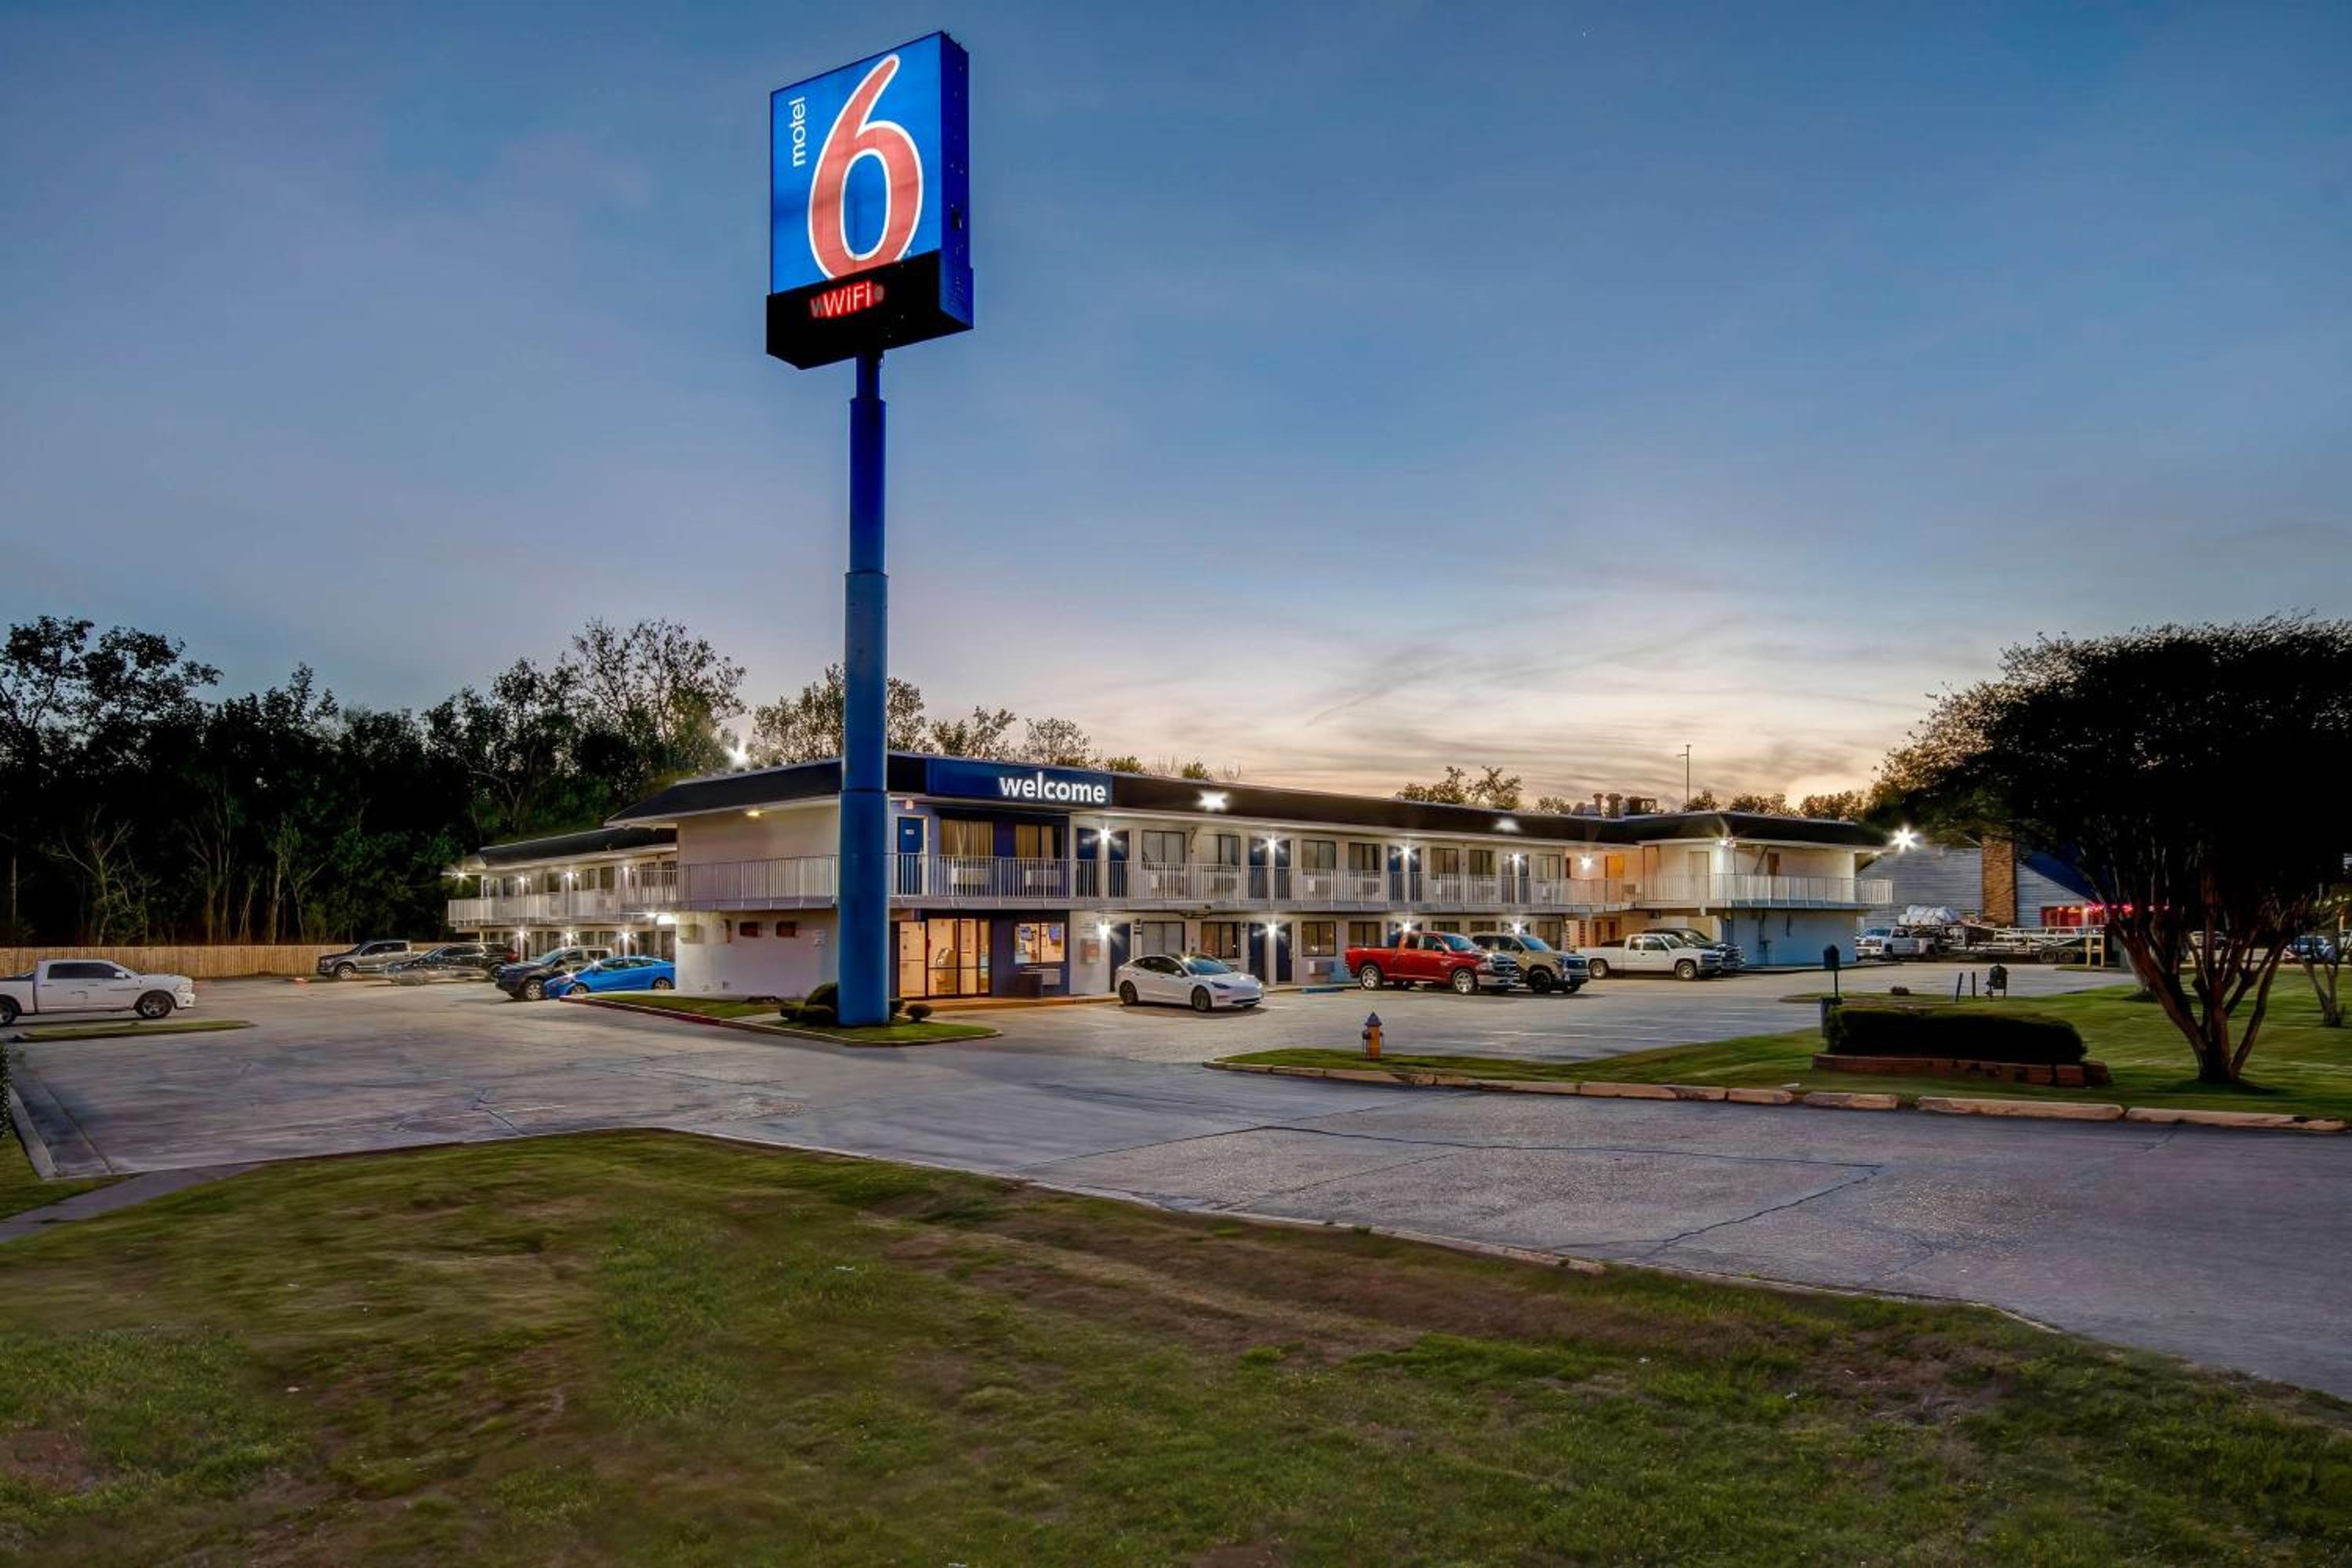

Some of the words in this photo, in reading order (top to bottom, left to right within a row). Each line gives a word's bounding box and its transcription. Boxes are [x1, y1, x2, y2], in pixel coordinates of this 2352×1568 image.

[788, 96, 806, 167] motel
[808, 54, 924, 280] 6
[999, 771, 1106, 803] welcome
